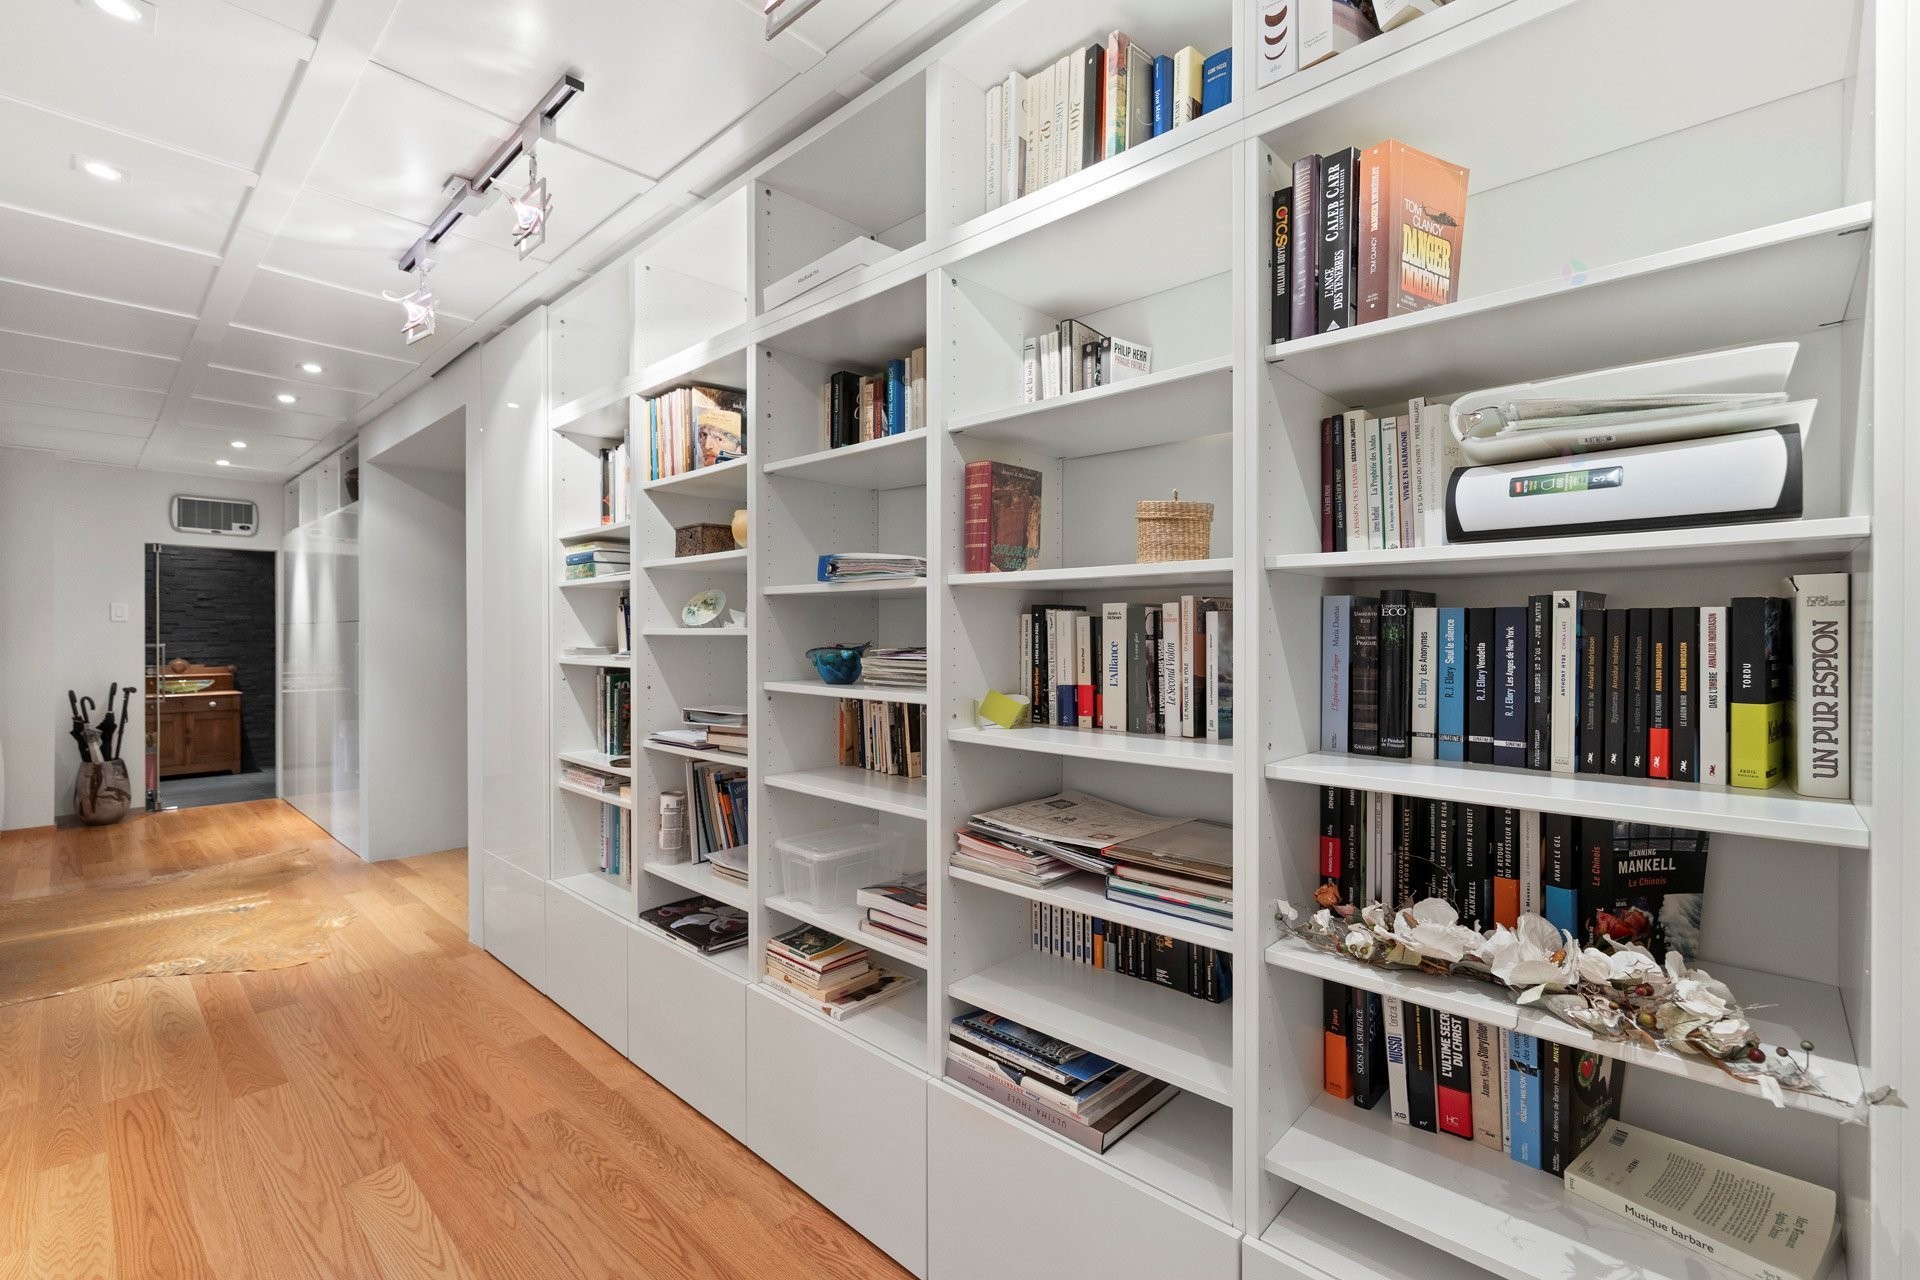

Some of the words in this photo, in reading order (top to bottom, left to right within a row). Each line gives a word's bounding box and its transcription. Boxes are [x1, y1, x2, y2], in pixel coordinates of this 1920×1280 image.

[1069, 98, 1081, 132] 200
[1040, 120, 1052, 142] 92
[1326, 163, 1340, 199] CARR
[1403, 198, 1422, 217] TOM
[1275, 206, 1288, 247] SOLO
[1325, 201, 1339, 242] CALEB
[1412, 214, 1443, 236] CLANCY
[1402, 222, 1452, 278] DANGER
[1324, 267, 1334, 297] L'ANGE
[1114, 342, 1132, 357] PHILIP
[1132, 348, 1148, 362] KERR
[1026, 377, 1033, 385] la
[1369, 434, 1377, 451] Andes
[1401, 431, 1409, 468] HARMONIE
[1369, 461, 1379, 488] Prophétie
[1402, 469, 1409, 479] EN
[1371, 487, 1378, 496] La
[1371, 506, 1380, 521] Redfield
[1354, 529, 1360, 538] LA
[1372, 521, 1380, 533] James
[993, 543, 1040, 558] COLORADO
[1003, 557, 1028, 570] SAGA
[1381, 607, 1407, 617] ECO
[1444, 618, 1455, 642] silence
[1505, 625, 1515, 639] York
[1707, 612, 1717, 643] INDRIDASON
[1165, 642, 1176, 666] Violon
[1419, 631, 1430, 663] Anonymes
[1505, 638, 1515, 652] New
[1505, 651, 1514, 659] de
[1587, 636, 1595, 665] Indridason
[1612, 635, 1620, 665] Indridason
[1680, 641, 1688, 669] INDRIDASON
[1109, 640, 1119, 687] L'Alliance
[1331, 653, 1340, 673] Tanger
[1445, 649, 1455, 664] Seul
[1476, 642, 1486, 669] Vendetta
[1655, 642, 1663, 669] INDRIDASON
[1707, 643, 1717, 669] ARNALDUR
[1811, 619, 1838, 698] ESPION
[1332, 673, 1339, 682] de
[1419, 663, 1427, 675] Les
[1505, 659, 1517, 676] Anges
[1611, 665, 1619, 689] Arnaldur
[1742, 663, 1752, 689] TORDU
[1166, 666, 1176, 698] Second
[1505, 676, 1514, 687] Les
[1587, 666, 1595, 690] Arnaldur
[1655, 668, 1663, 692] ARNALDUR
[1679, 668, 1688, 692] ARNALDUR
[1708, 671, 1718, 694] L'OMBRE
[1166, 697, 1176, 706] Le
[1330, 682, 1340, 712] L'Espionne
[1708, 694, 1718, 709] DANS
[1680, 706, 1688, 721] LAGON
[1813, 701, 1838, 745] PUR
[1812, 747, 1838, 779] UN
[1440, 819, 1447, 828] DE
[1505, 816, 1512, 825] DE
[1554, 849, 1561, 859] LE
[1592, 846, 1601, 875] Chinois
[1628, 848, 1657, 857] HENNING
[1348, 860, 1354, 869] Un
[1497, 869, 1504, 877] LE
[1505, 869, 1512, 879] DU
[1618, 857, 1677, 874] MANKELL
[1592, 876, 1601, 886] Le
[1628, 878, 1637, 888] Le
[1639, 876, 1667, 886] Chinois
[1468, 881, 1476, 916] MANKELL
[1331, 1008, 1339, 1025] jours
[1356, 1008, 1364, 1042] SURFACE
[1451, 1017, 1463, 1052] CHRIST
[1356, 1042, 1364, 1053] LA
[1387, 1035, 1404, 1065] MUSSO
[1357, 1053, 1365, 1075] SOUS
[1452, 1052, 1464, 1068] DU
[1552, 1067, 1560, 1083] House
[1005, 1092, 1033, 1112] THULÉ
[1552, 1083, 1560, 1102] Barton
[1553, 1103, 1559, 1112] de
[1035, 1107, 1068, 1129] ULTIMA
[1552, 1111, 1560, 1131] démons
[1624, 1203, 1669, 1233] Musique
[1670, 1226, 1715, 1255] barbare
